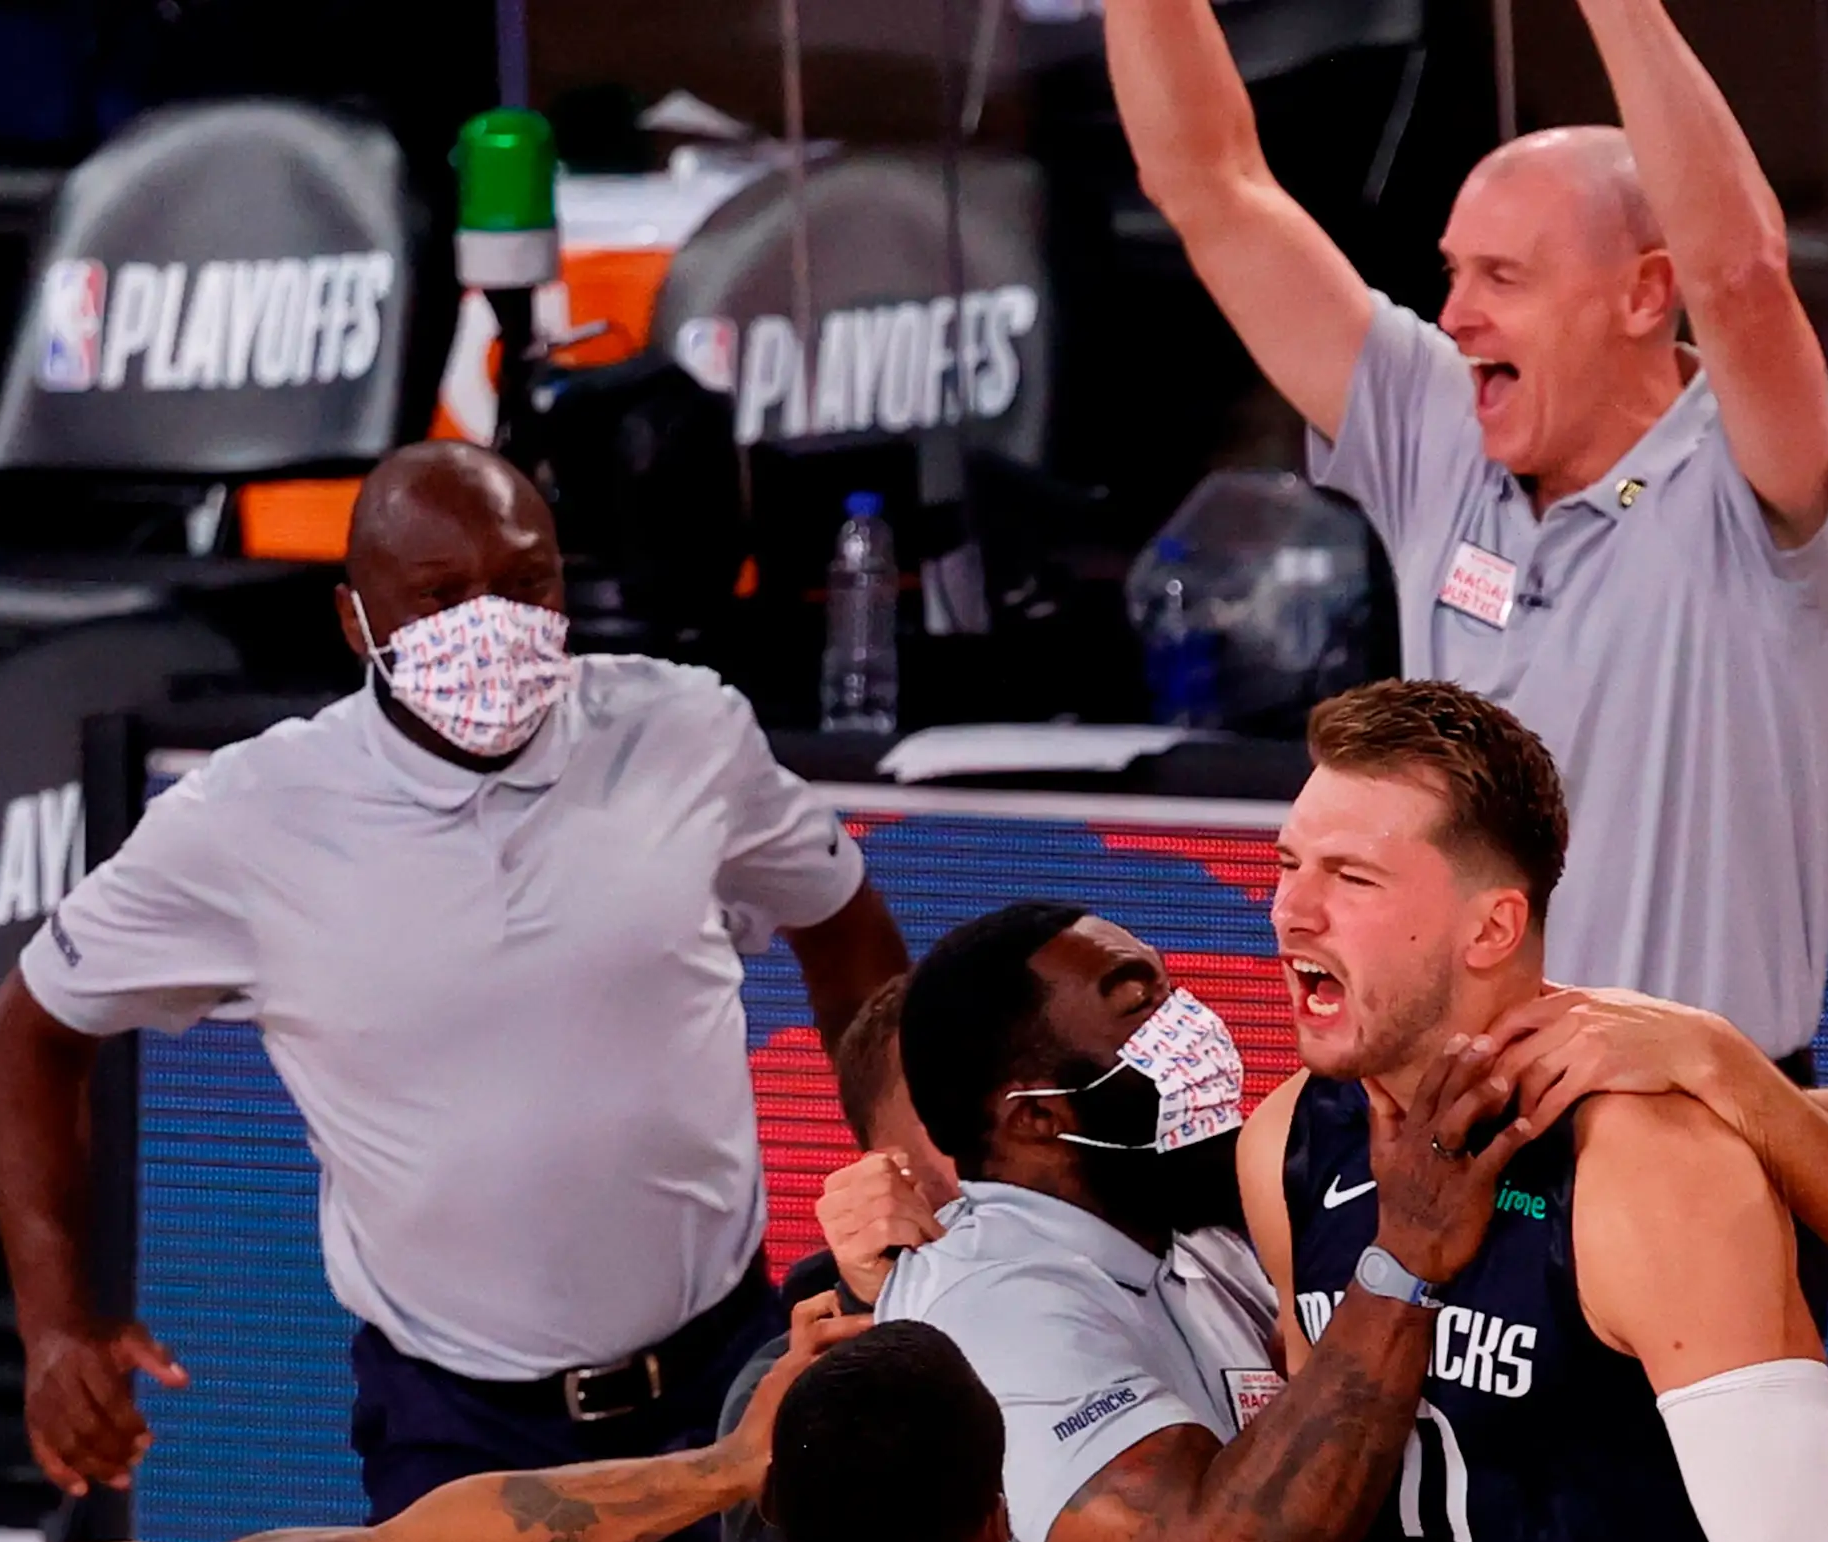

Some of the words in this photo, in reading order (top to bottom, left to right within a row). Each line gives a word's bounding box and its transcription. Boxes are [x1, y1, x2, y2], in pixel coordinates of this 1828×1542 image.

[99, 252, 393, 390] PLAYOFFS
[1495, 1180, 1547, 1220] ime
[1052, 1387, 1138, 1442] MAVERICKS
